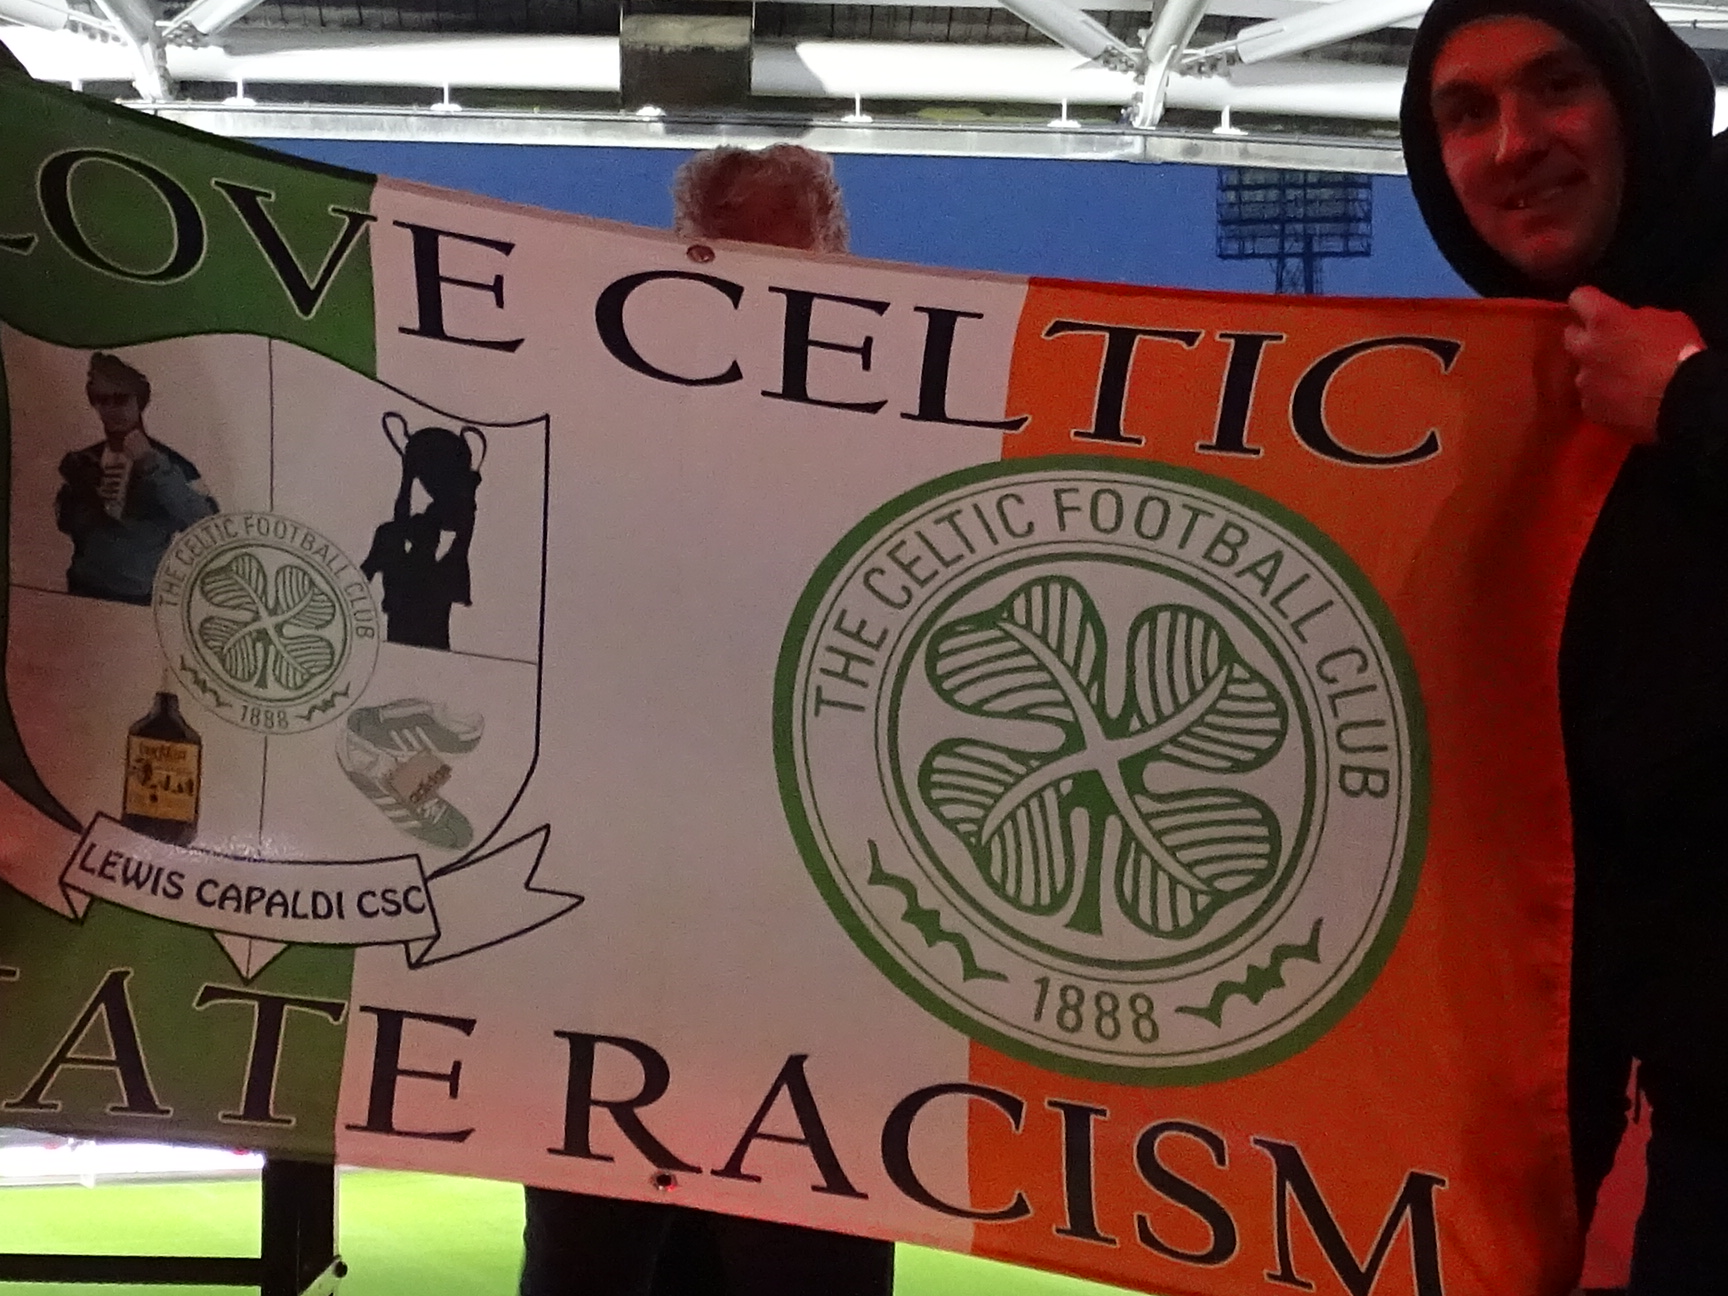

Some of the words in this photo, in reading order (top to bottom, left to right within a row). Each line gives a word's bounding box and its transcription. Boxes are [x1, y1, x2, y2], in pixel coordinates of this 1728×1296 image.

[594, 268, 1465, 467] CELTIC
[159, 563, 187, 606] THE
[175, 519, 238, 565] CELTIC
[243, 516, 348, 577] FOOTBALL
[345, 581, 375, 639] CLUB
[814, 609, 889, 717] THE
[862, 493, 1034, 610] CELTIC
[1053, 487, 1334, 644] FOOTBALL
[1315, 644, 1390, 801] CLUB
[240, 704, 289, 729] 1888
[78, 842, 185, 899] LEWIS
[195, 878, 345, 920] CAPALDI
[356, 885, 426, 918] CSC
[1032, 976, 1160, 1044] 1888
